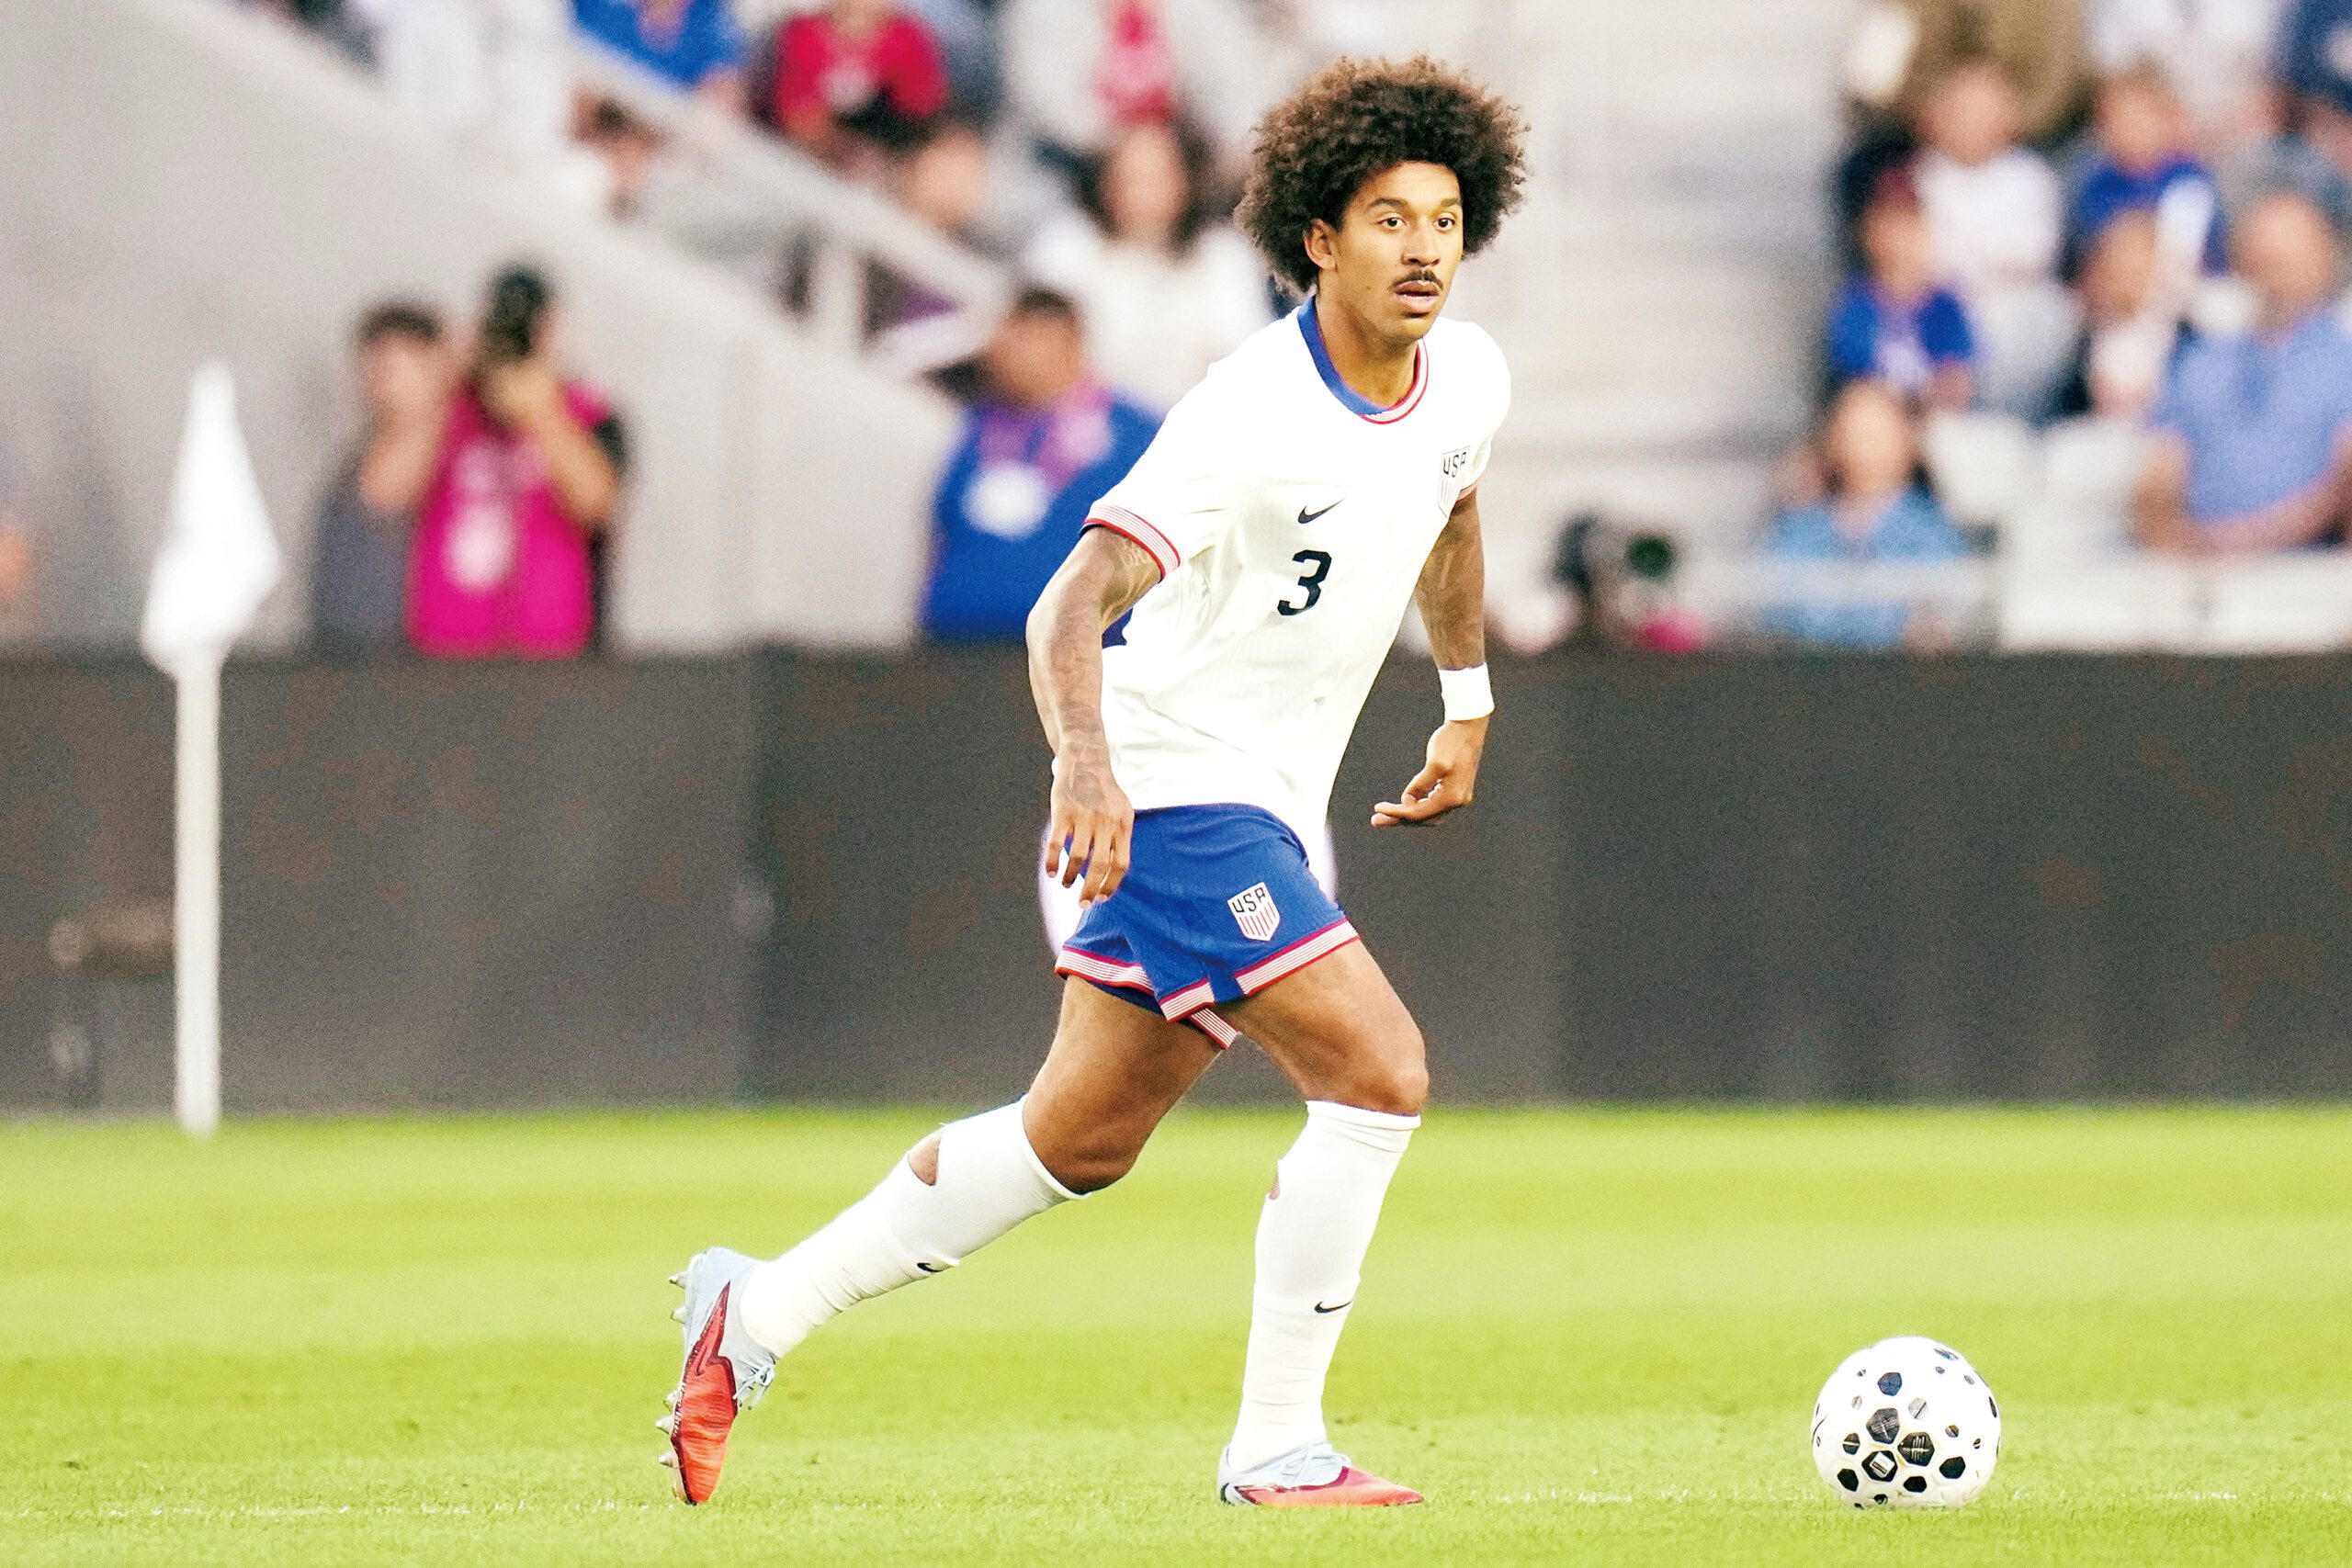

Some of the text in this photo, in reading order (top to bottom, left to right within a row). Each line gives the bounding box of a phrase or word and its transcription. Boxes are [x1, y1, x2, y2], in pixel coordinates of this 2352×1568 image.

[1442, 451, 1467, 478] USA
[1277, 549, 1332, 616] 3
[1232, 886, 1266, 913] USA
